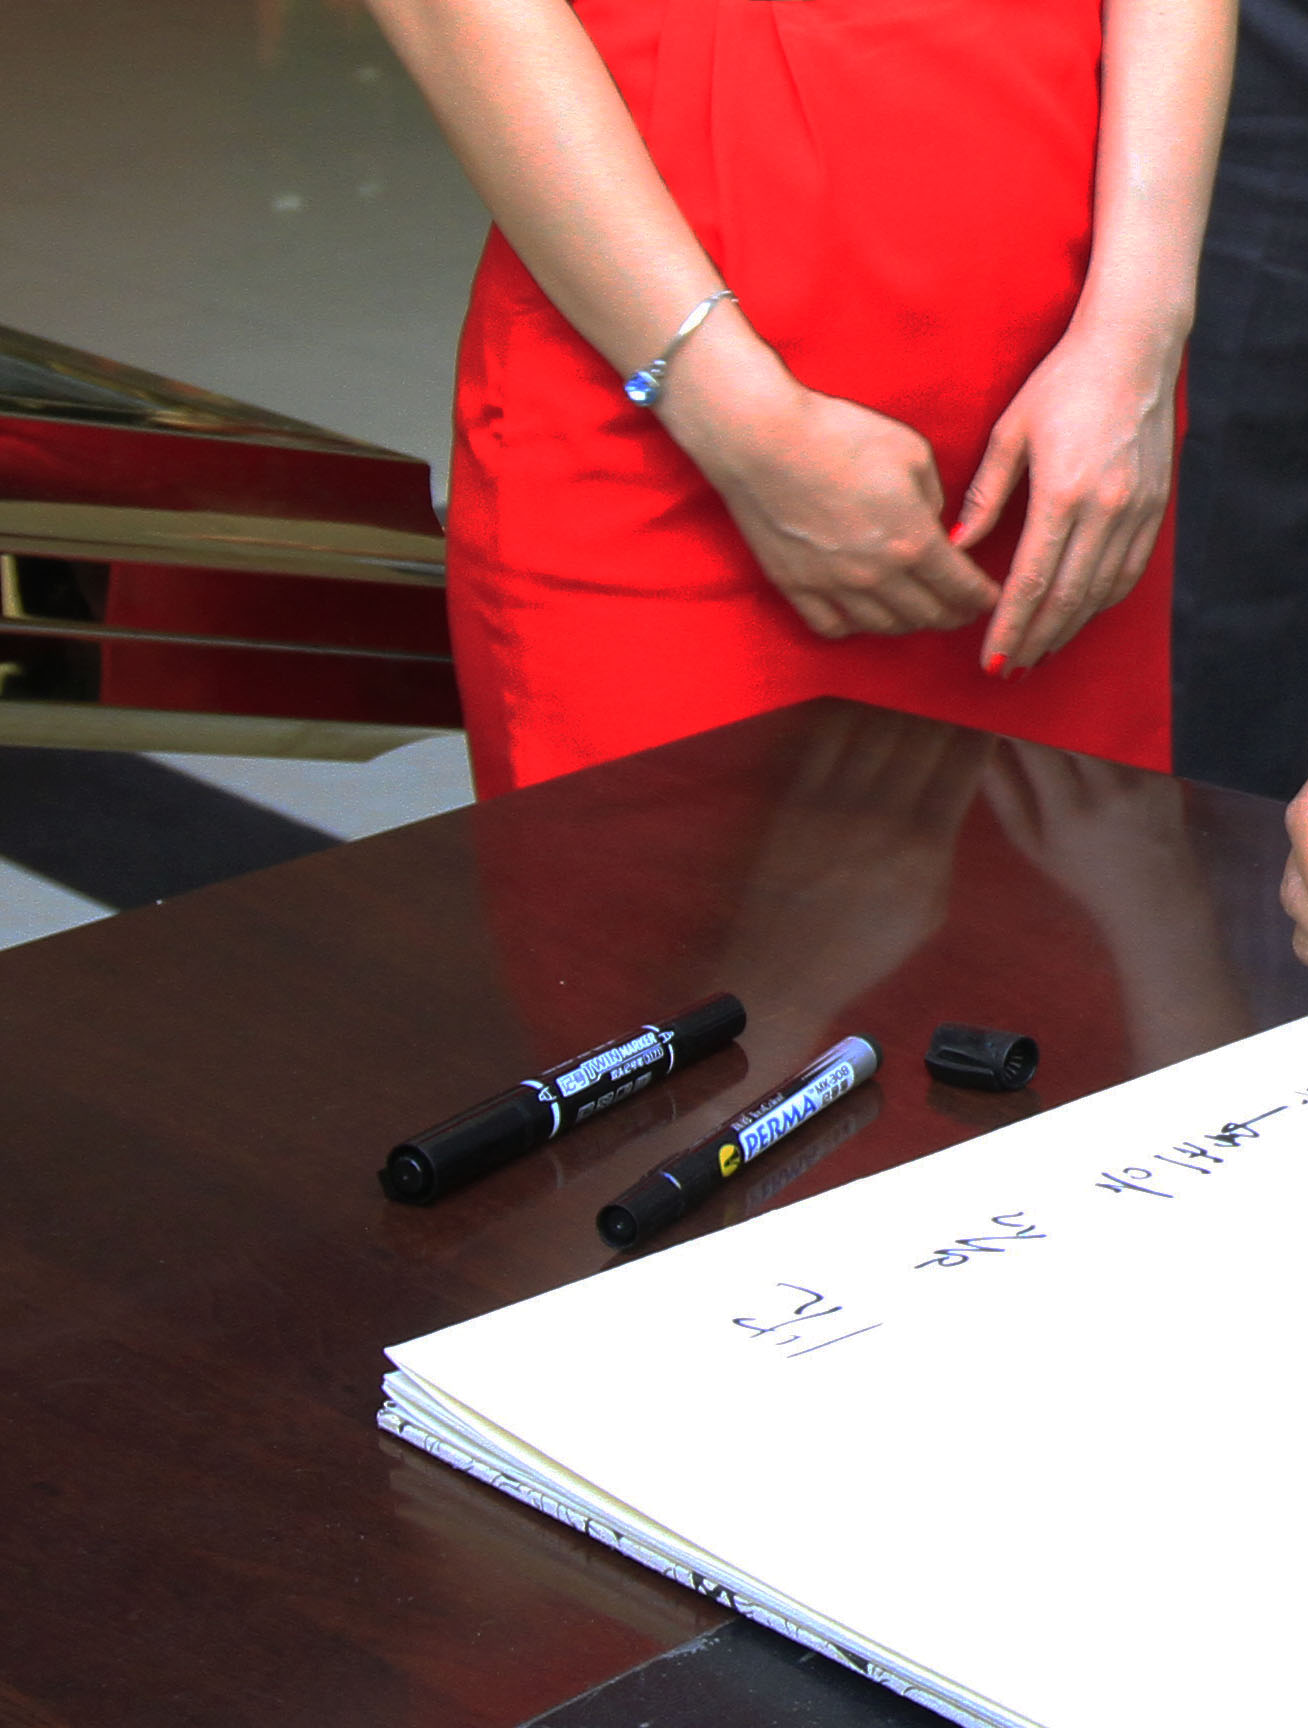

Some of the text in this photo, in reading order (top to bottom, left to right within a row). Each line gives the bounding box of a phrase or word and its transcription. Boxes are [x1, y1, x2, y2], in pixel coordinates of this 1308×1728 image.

[580, 1048, 623, 1080] TWIN
[620, 1032, 658, 1058] MARKER
[744, 1095, 818, 1159] PERMA
